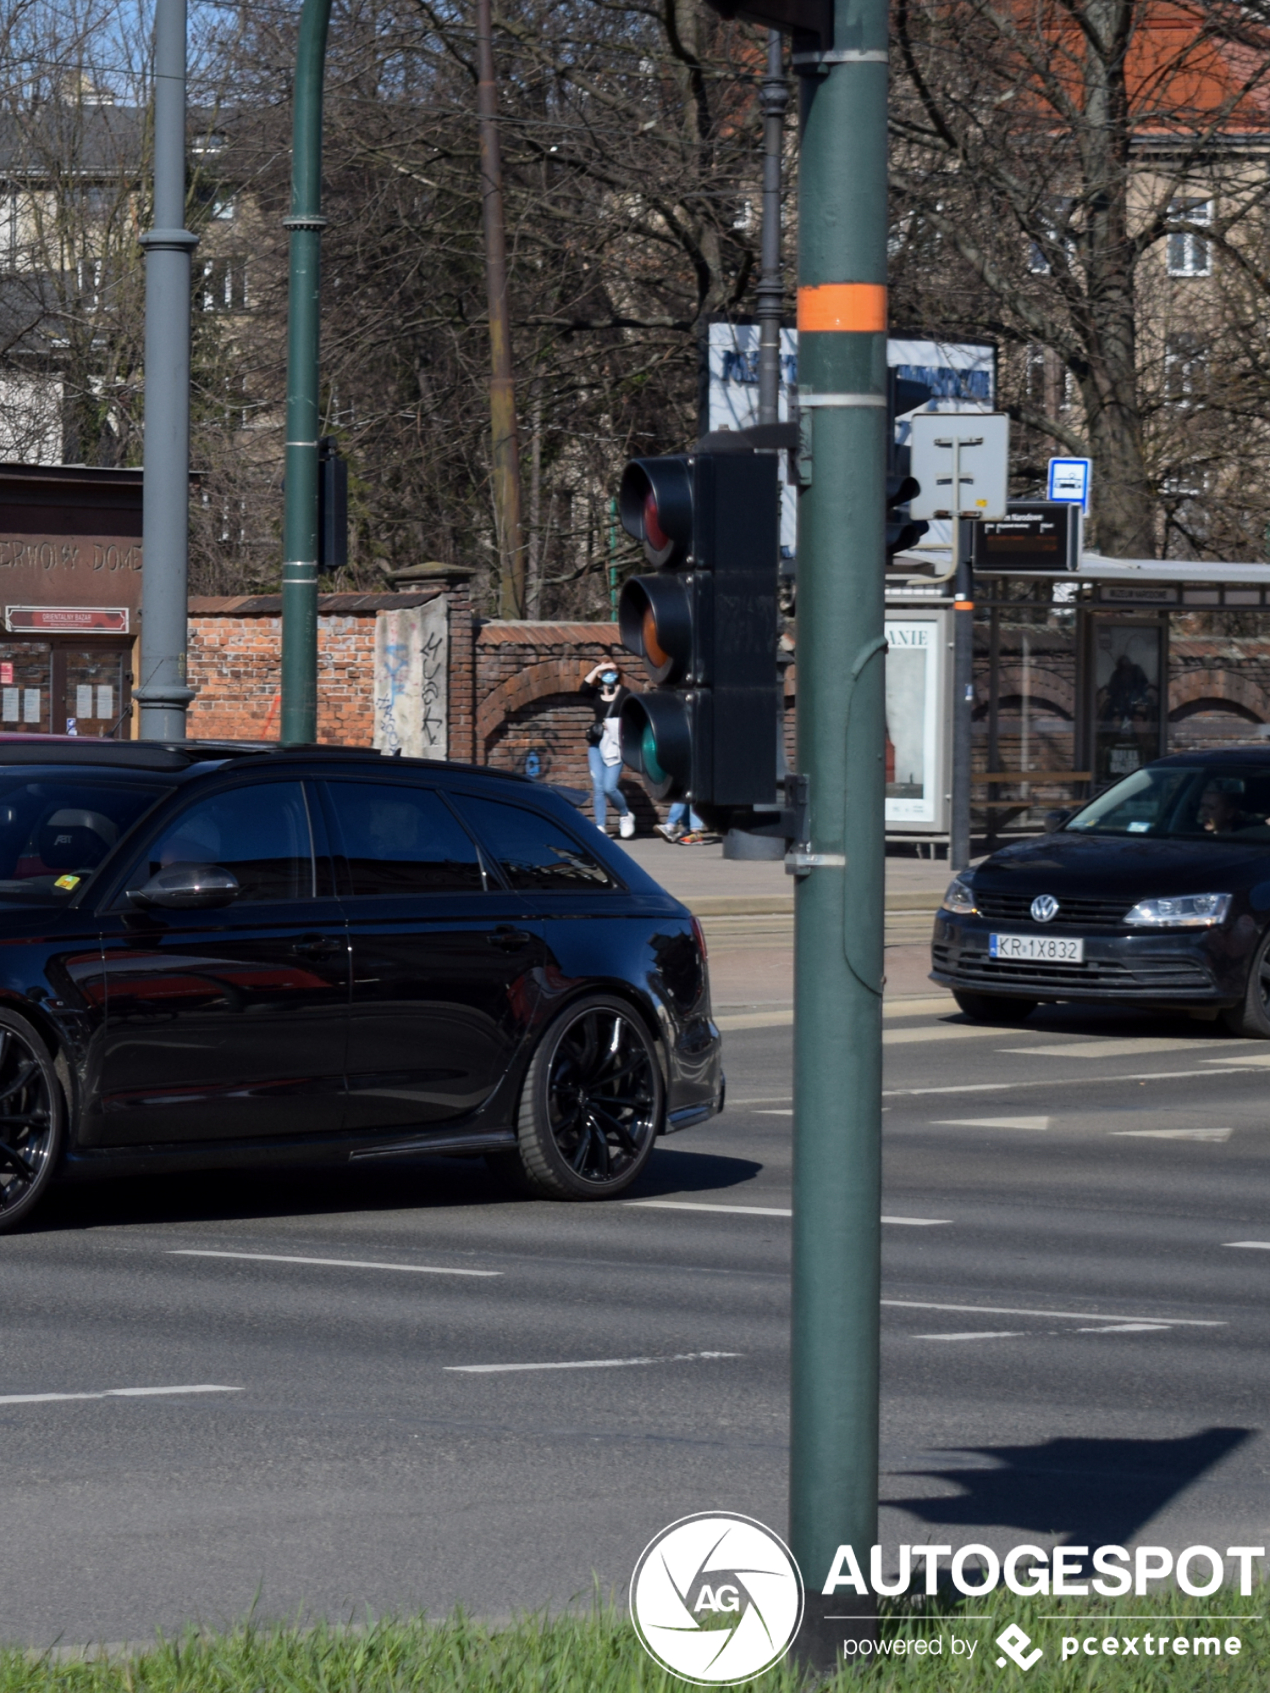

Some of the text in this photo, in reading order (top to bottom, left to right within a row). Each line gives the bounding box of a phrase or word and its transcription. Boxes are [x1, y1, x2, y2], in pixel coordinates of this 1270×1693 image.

[92, 543, 143, 572] DOME
[887, 630, 928, 646] ANIE
[999, 937, 1077, 959] KR 1X832
